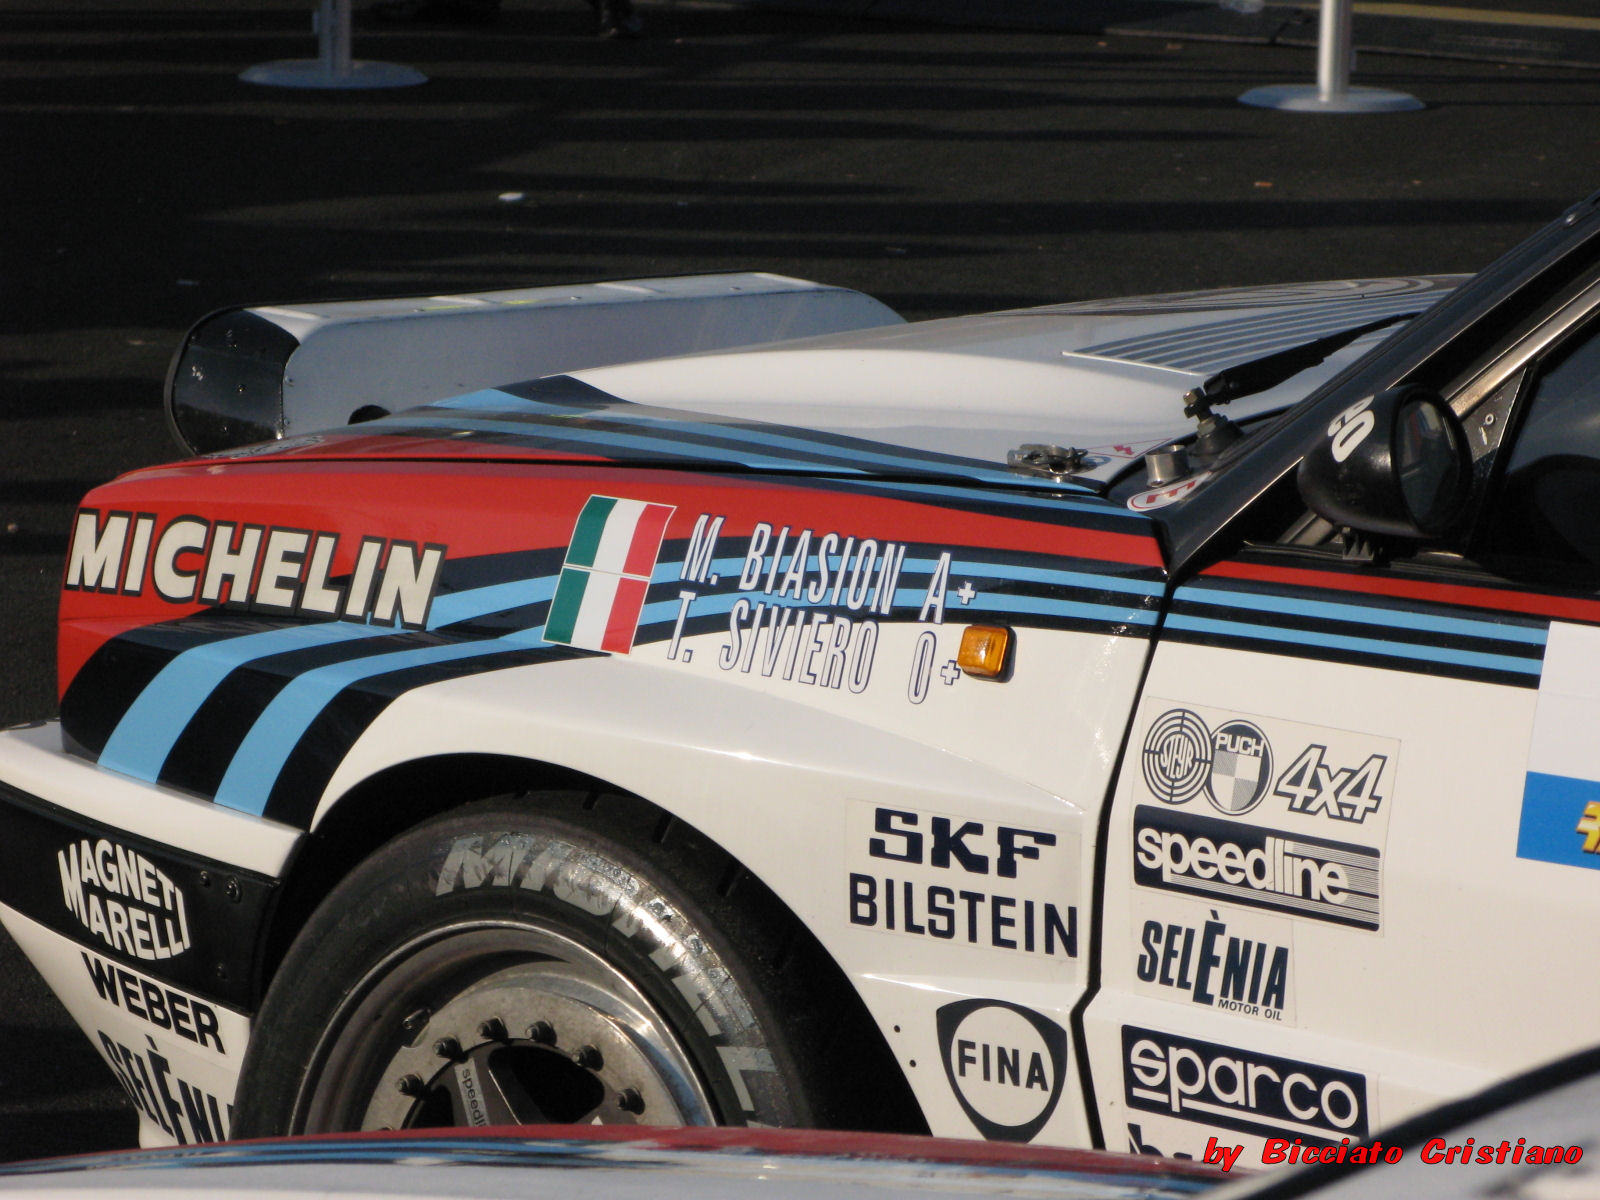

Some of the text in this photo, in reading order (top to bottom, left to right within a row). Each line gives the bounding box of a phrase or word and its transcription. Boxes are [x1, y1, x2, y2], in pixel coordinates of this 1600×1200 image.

[64, 507, 448, 630] MICHELIN
[679, 513, 726, 587] M.
[738, 522, 908, 616] BIASION
[667, 590, 698, 664] T.
[718, 597, 880, 695] SIVIERO
[1160, 734, 1194, 780] STEYR
[1215, 732, 1265, 758] PUCH
[58, 839, 189, 925] MAGNETI
[869, 807, 1057, 879] SKF
[1136, 827, 1350, 905] speedline
[64, 884, 191, 960] MARELLI
[849, 872, 1078, 958] BILSTEIN
[1137, 909, 1289, 1010] SELÈNIA
[80, 951, 226, 1055] WEBER
[1218, 999, 1283, 1021] MOTOR OIL
[957, 1039, 1049, 1092] FINA
[1130, 1039, 1359, 1129] sparco
